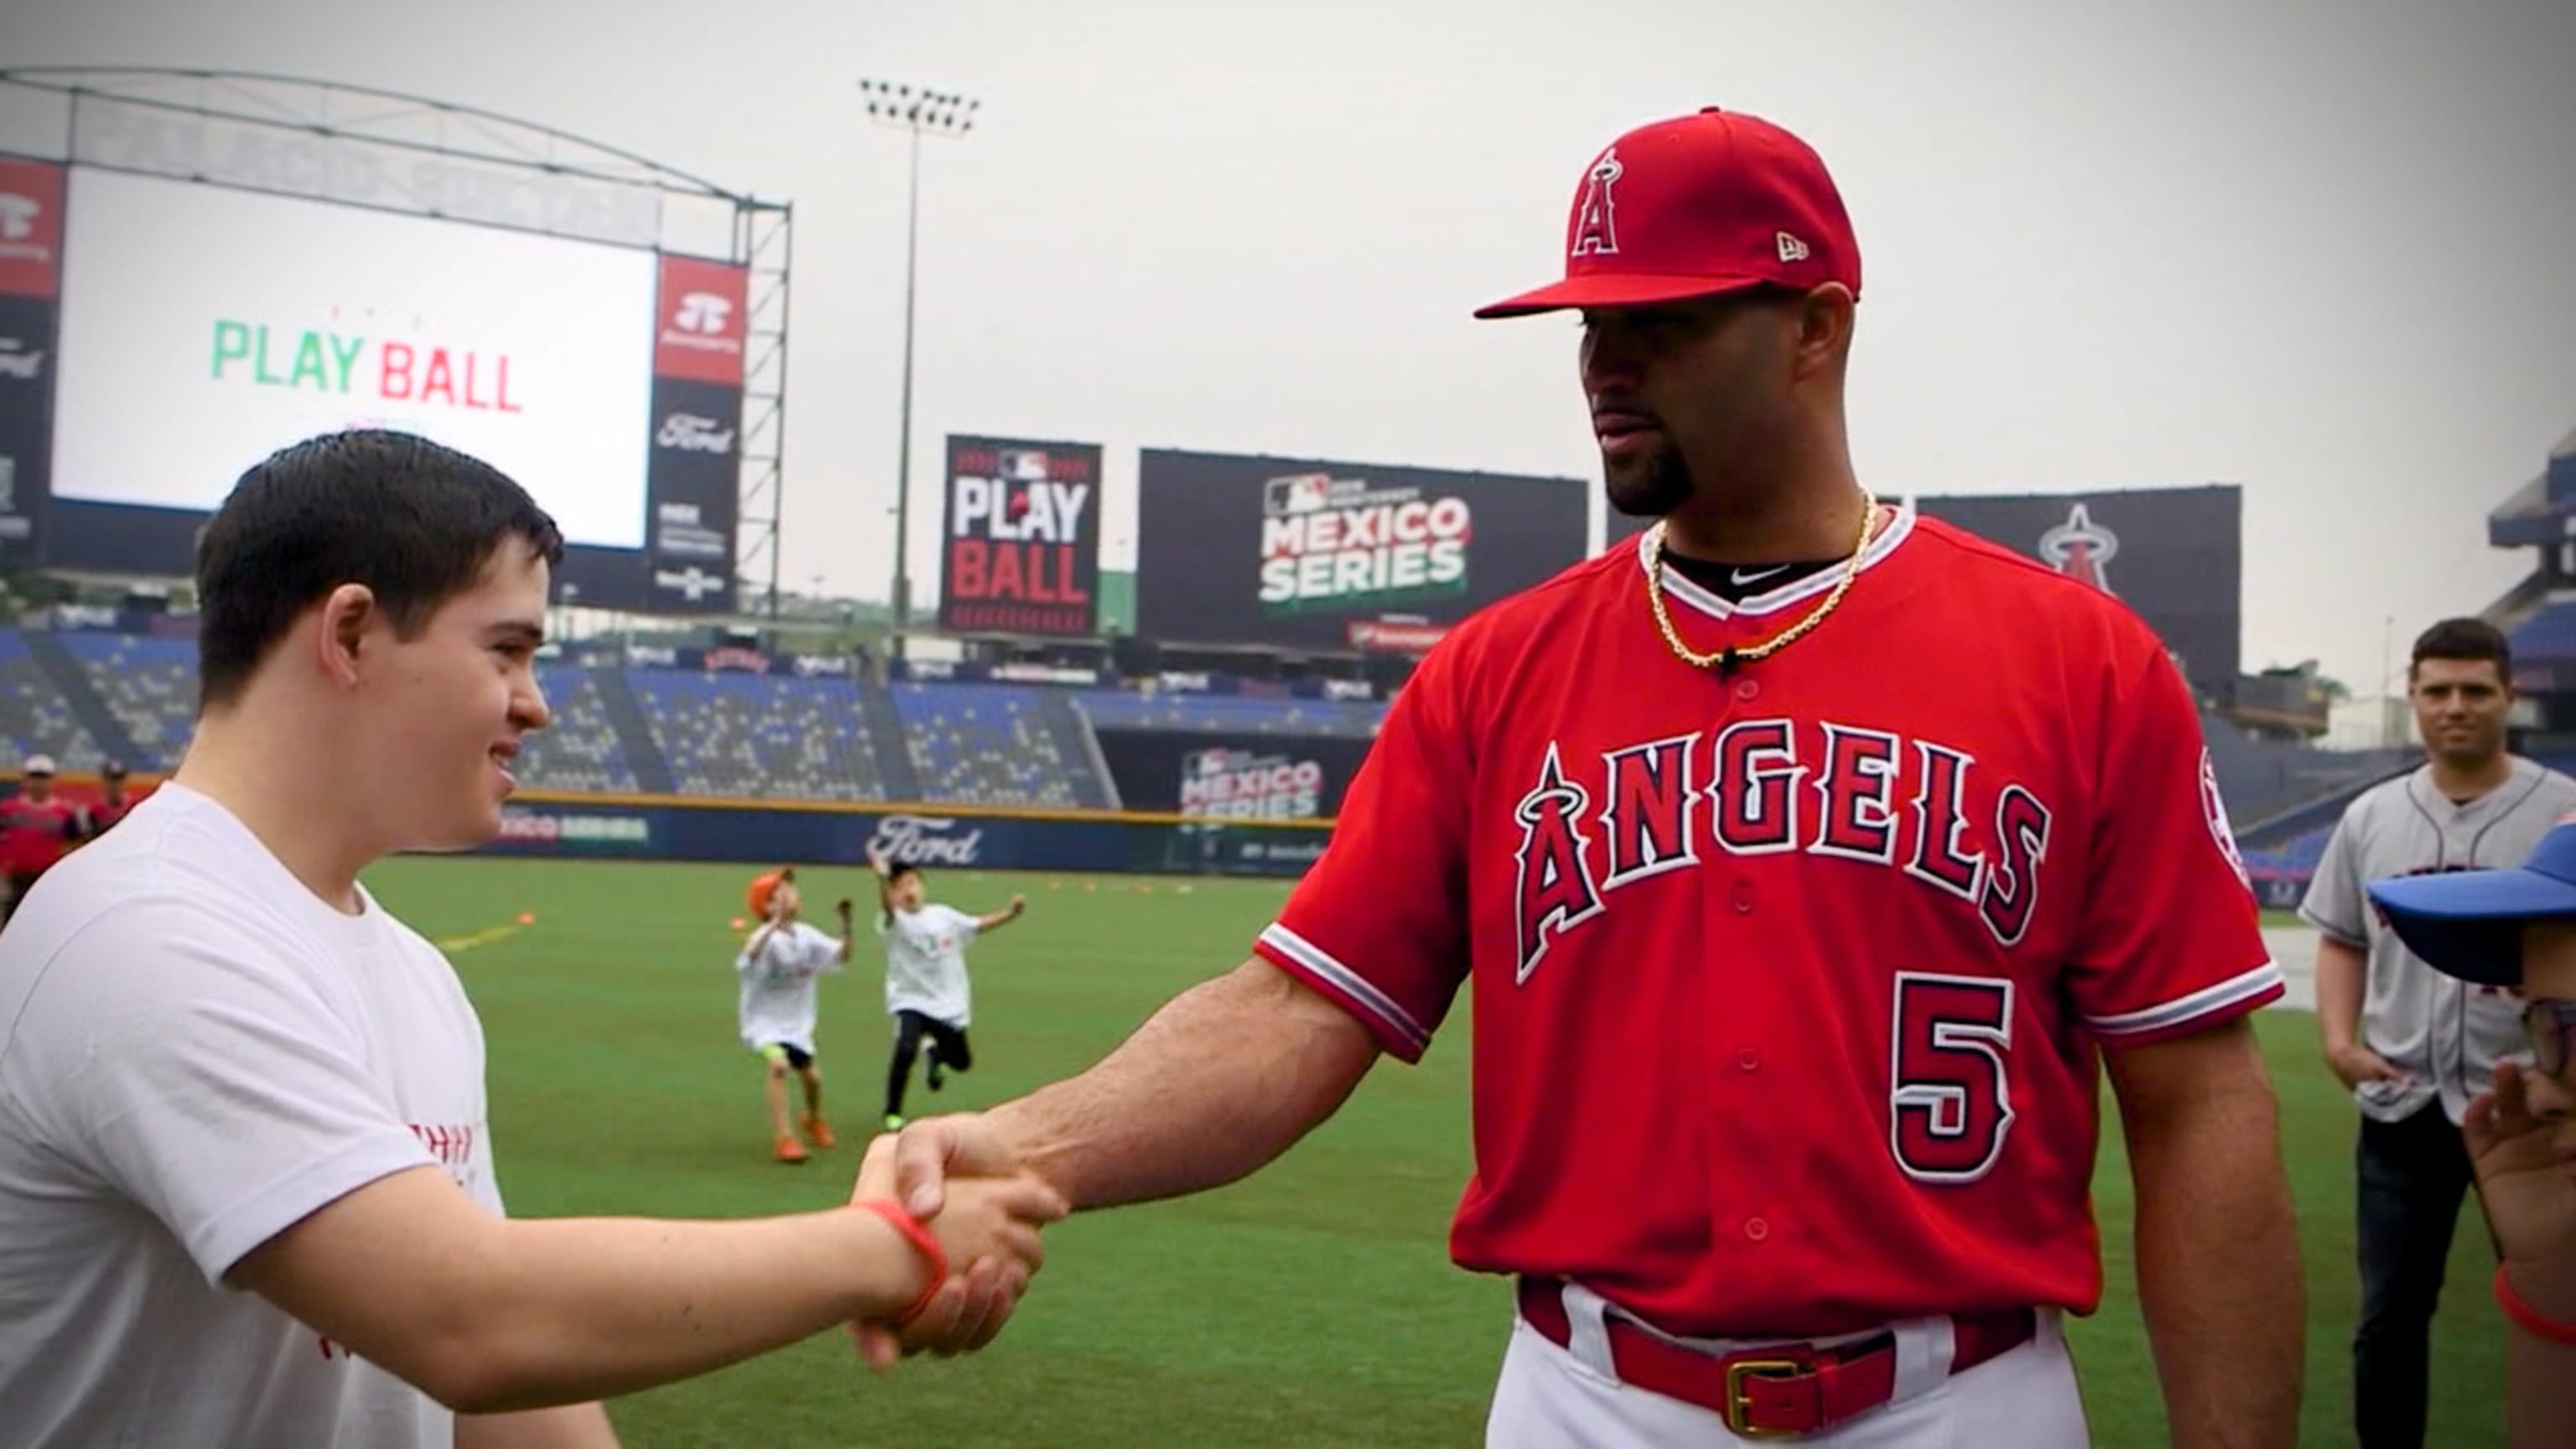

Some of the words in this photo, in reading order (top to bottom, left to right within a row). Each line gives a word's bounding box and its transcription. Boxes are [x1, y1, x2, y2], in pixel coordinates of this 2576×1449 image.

[212, 319, 365, 393] PLAY
[379, 341, 522, 413] BALL
[953, 475, 1088, 543] PLAY
[1261, 497, 1469, 558] MEXICO
[951, 538, 1087, 604] BALL
[1258, 540, 1466, 602] SERIES
[1181, 761, 1322, 806] MEXICO
[865, 814, 984, 865] Ford
[1514, 718, 2051, 985] ANGELS
[1891, 971, 2015, 1183] 5
